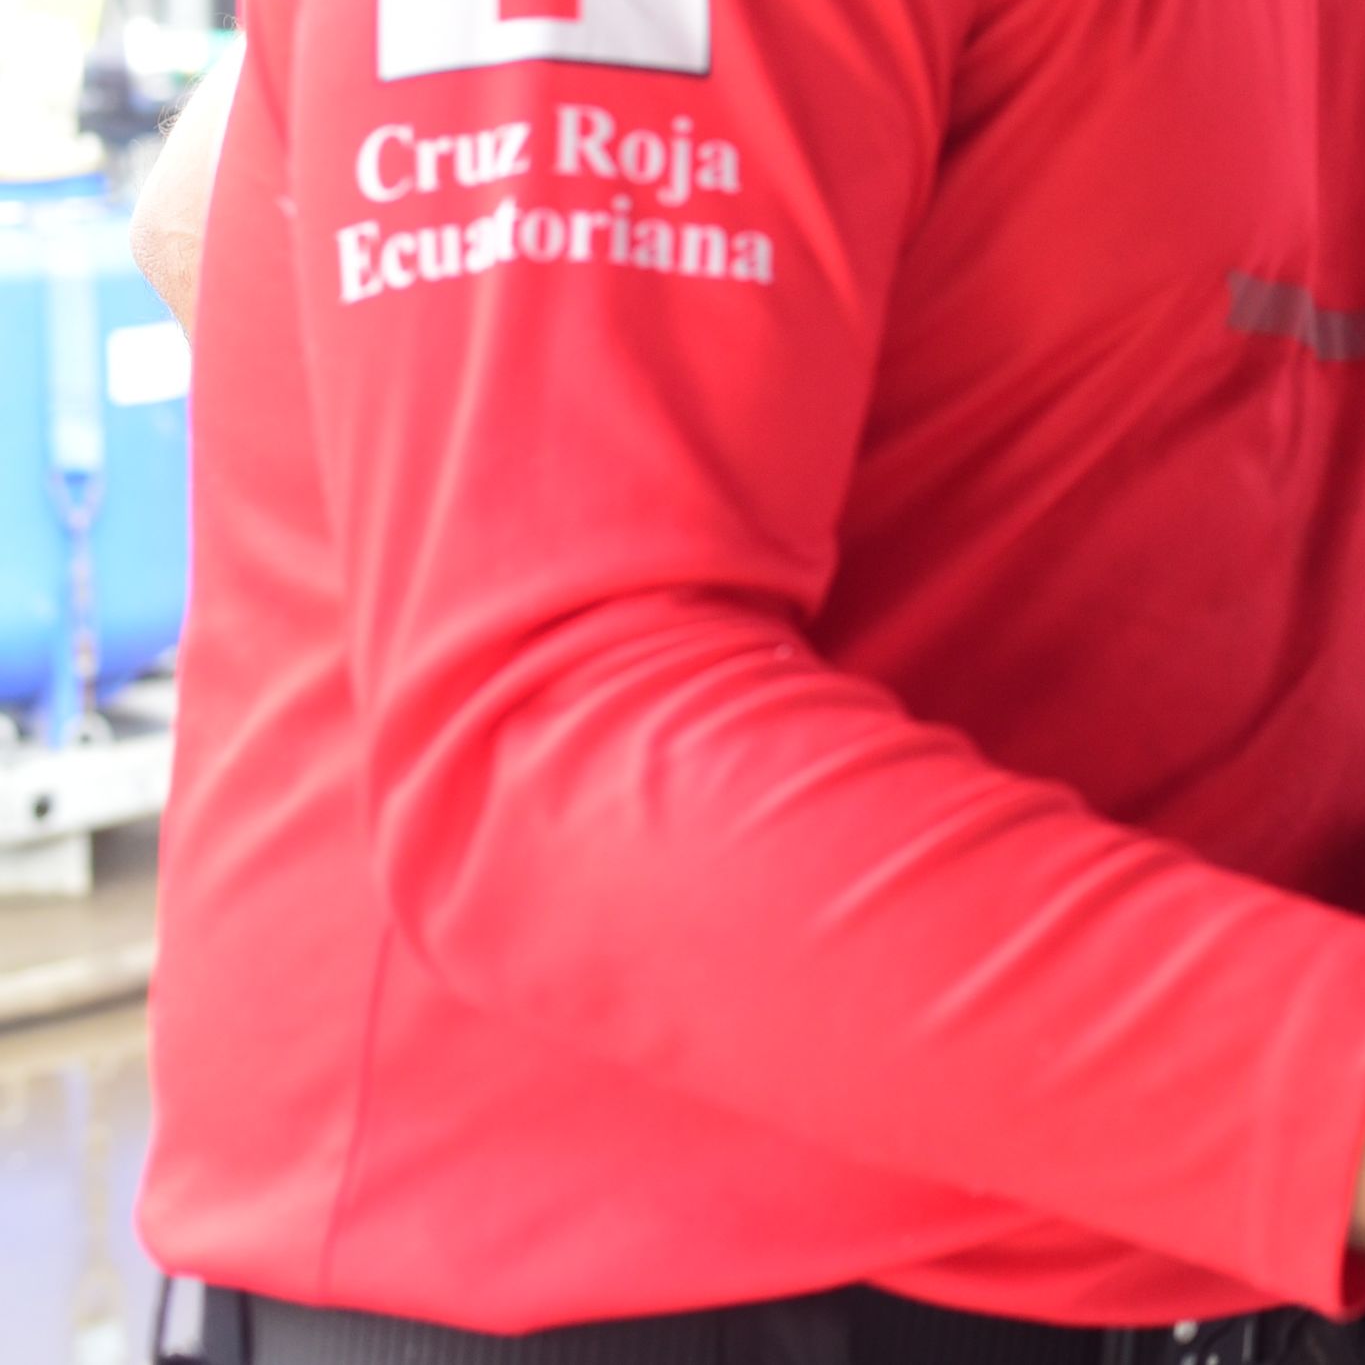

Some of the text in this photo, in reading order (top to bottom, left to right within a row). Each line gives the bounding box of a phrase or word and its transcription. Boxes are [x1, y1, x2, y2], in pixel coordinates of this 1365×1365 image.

[355, 103, 742, 208] Cruz Roja
[336, 195, 776, 305] Ecuatoriana
